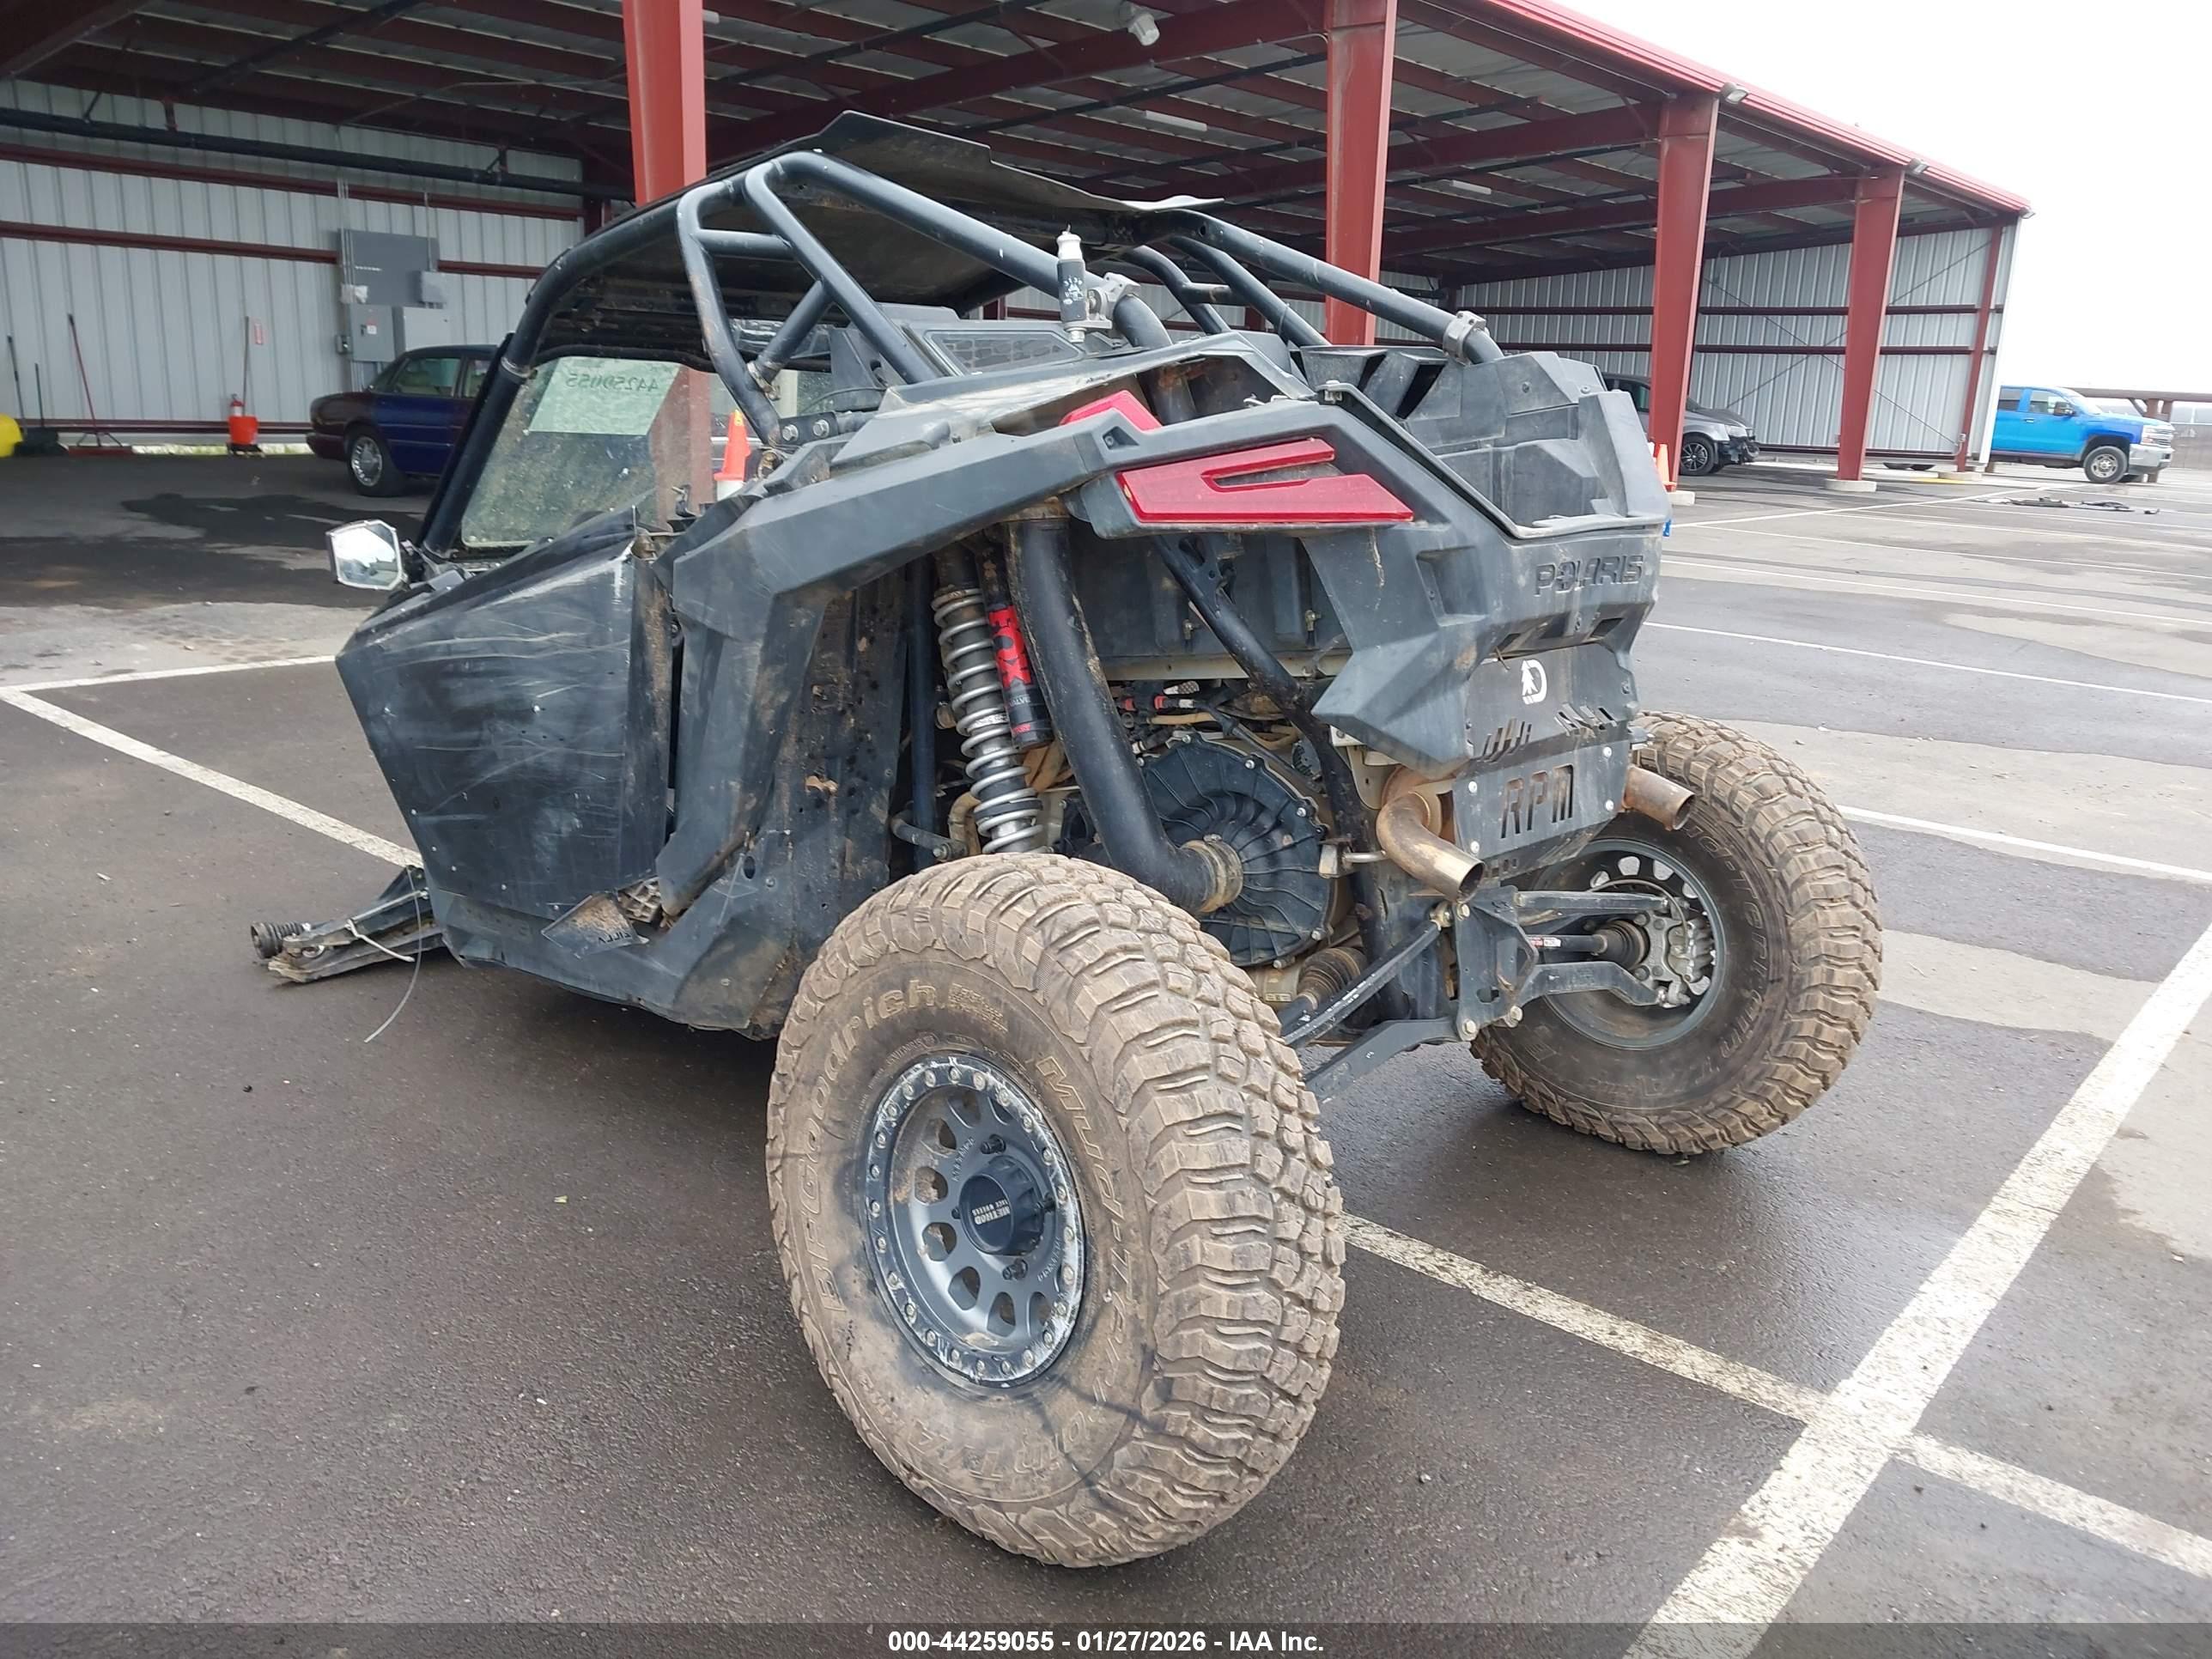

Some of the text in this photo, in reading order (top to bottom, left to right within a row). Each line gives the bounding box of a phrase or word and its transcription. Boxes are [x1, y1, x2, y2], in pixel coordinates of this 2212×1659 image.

[1534, 555, 1644, 597] POLARIS
[989, 605, 1031, 691] FOX
[1500, 763, 1574, 839] RPM
[799, 978, 938, 1313] BFGoodrich
[975, 1206, 1011, 1224] METHOD
